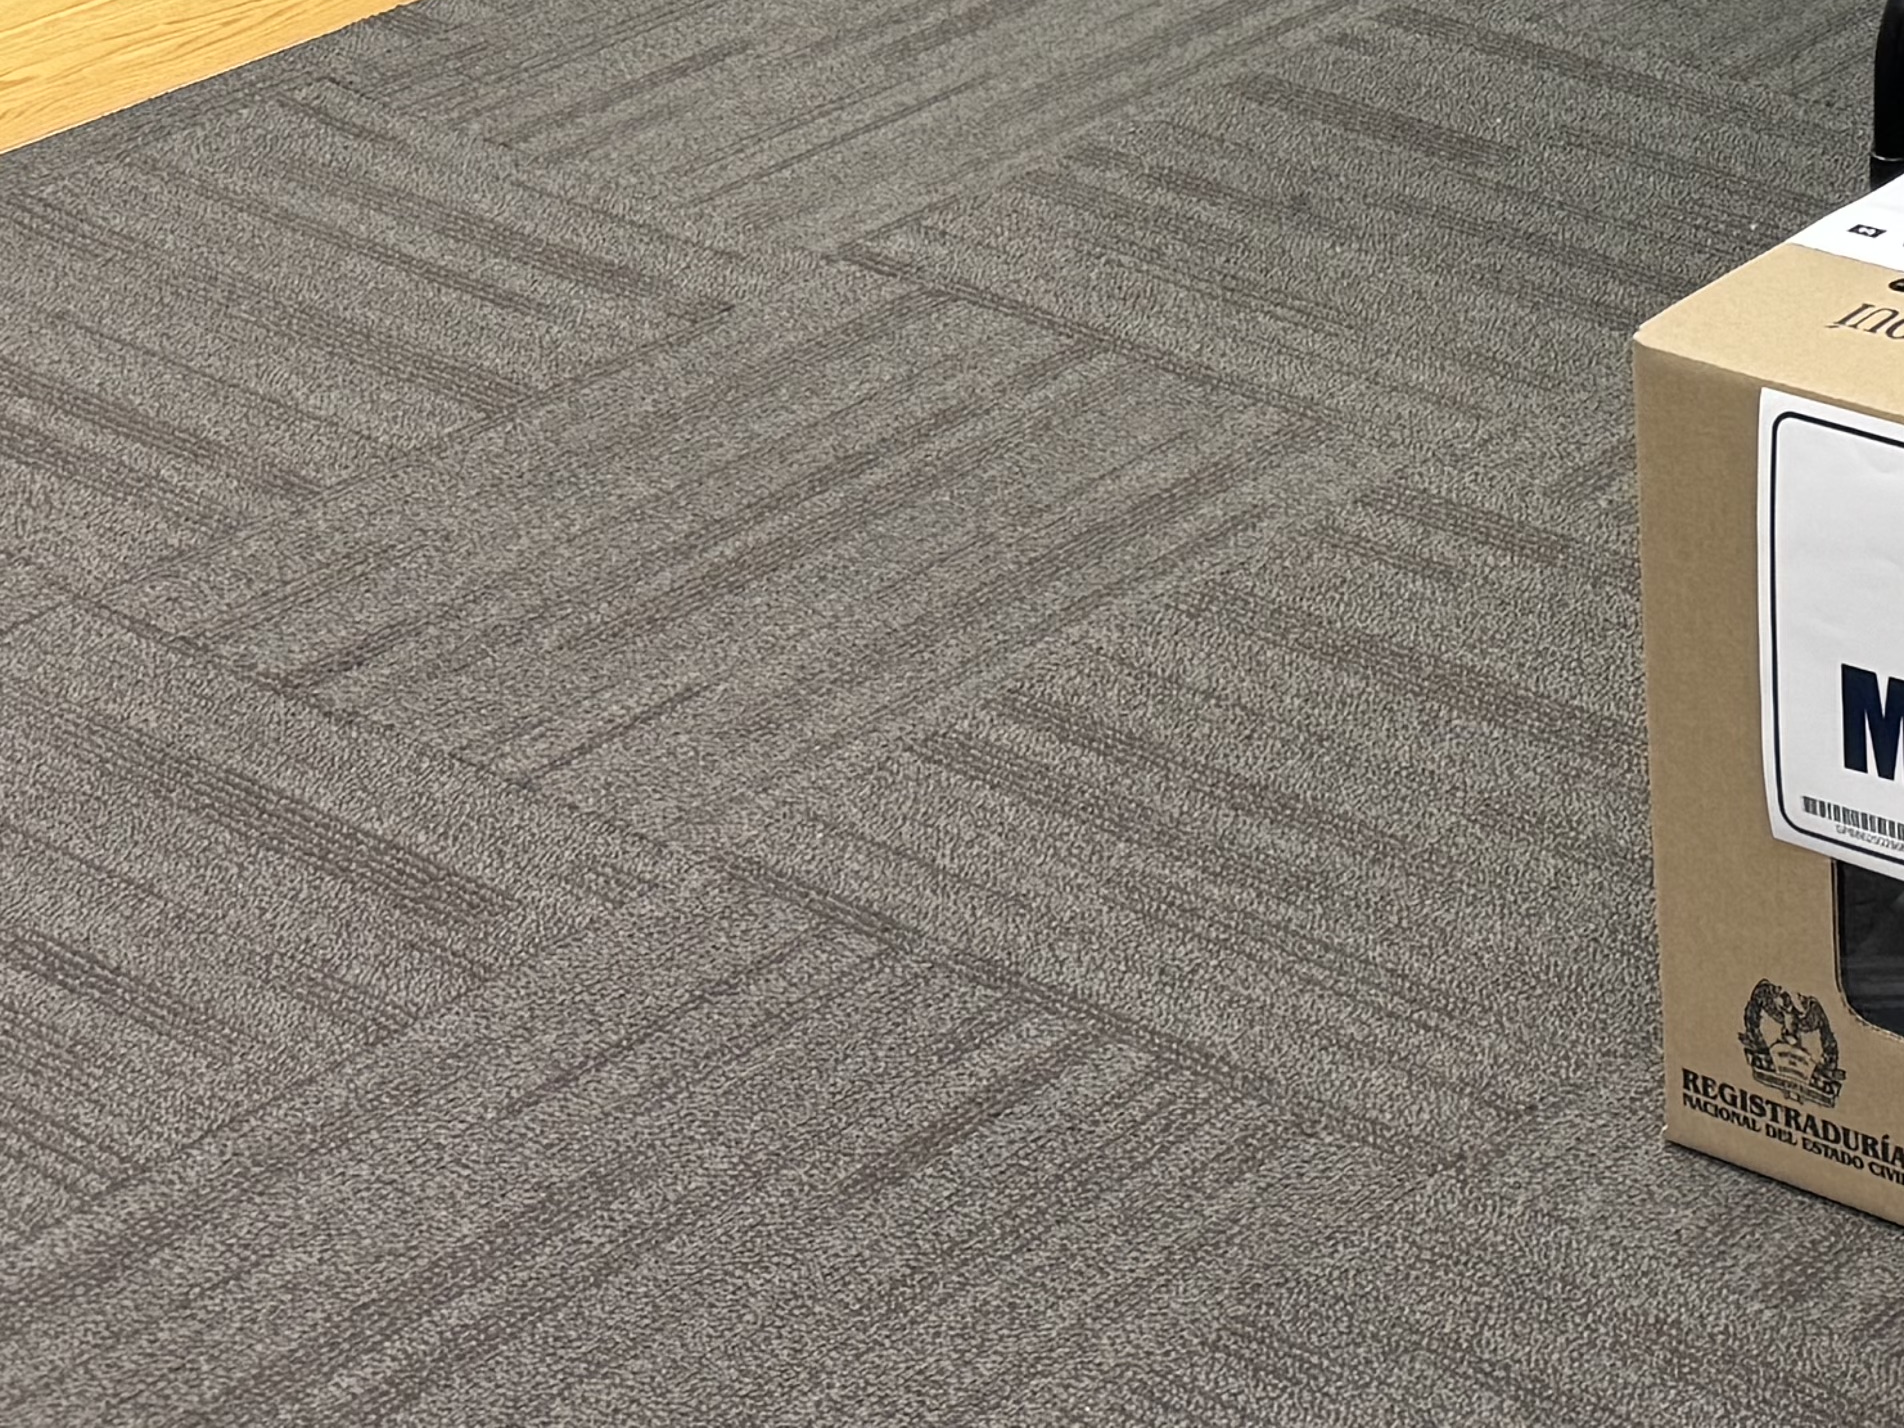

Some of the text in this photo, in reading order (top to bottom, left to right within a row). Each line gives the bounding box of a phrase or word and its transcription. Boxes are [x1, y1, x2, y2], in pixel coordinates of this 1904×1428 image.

[1683, 1093, 1761, 1131] NACIONAL
[1765, 1124, 1798, 1146] DEL
[1803, 1136, 1865, 1167] ESTADO
